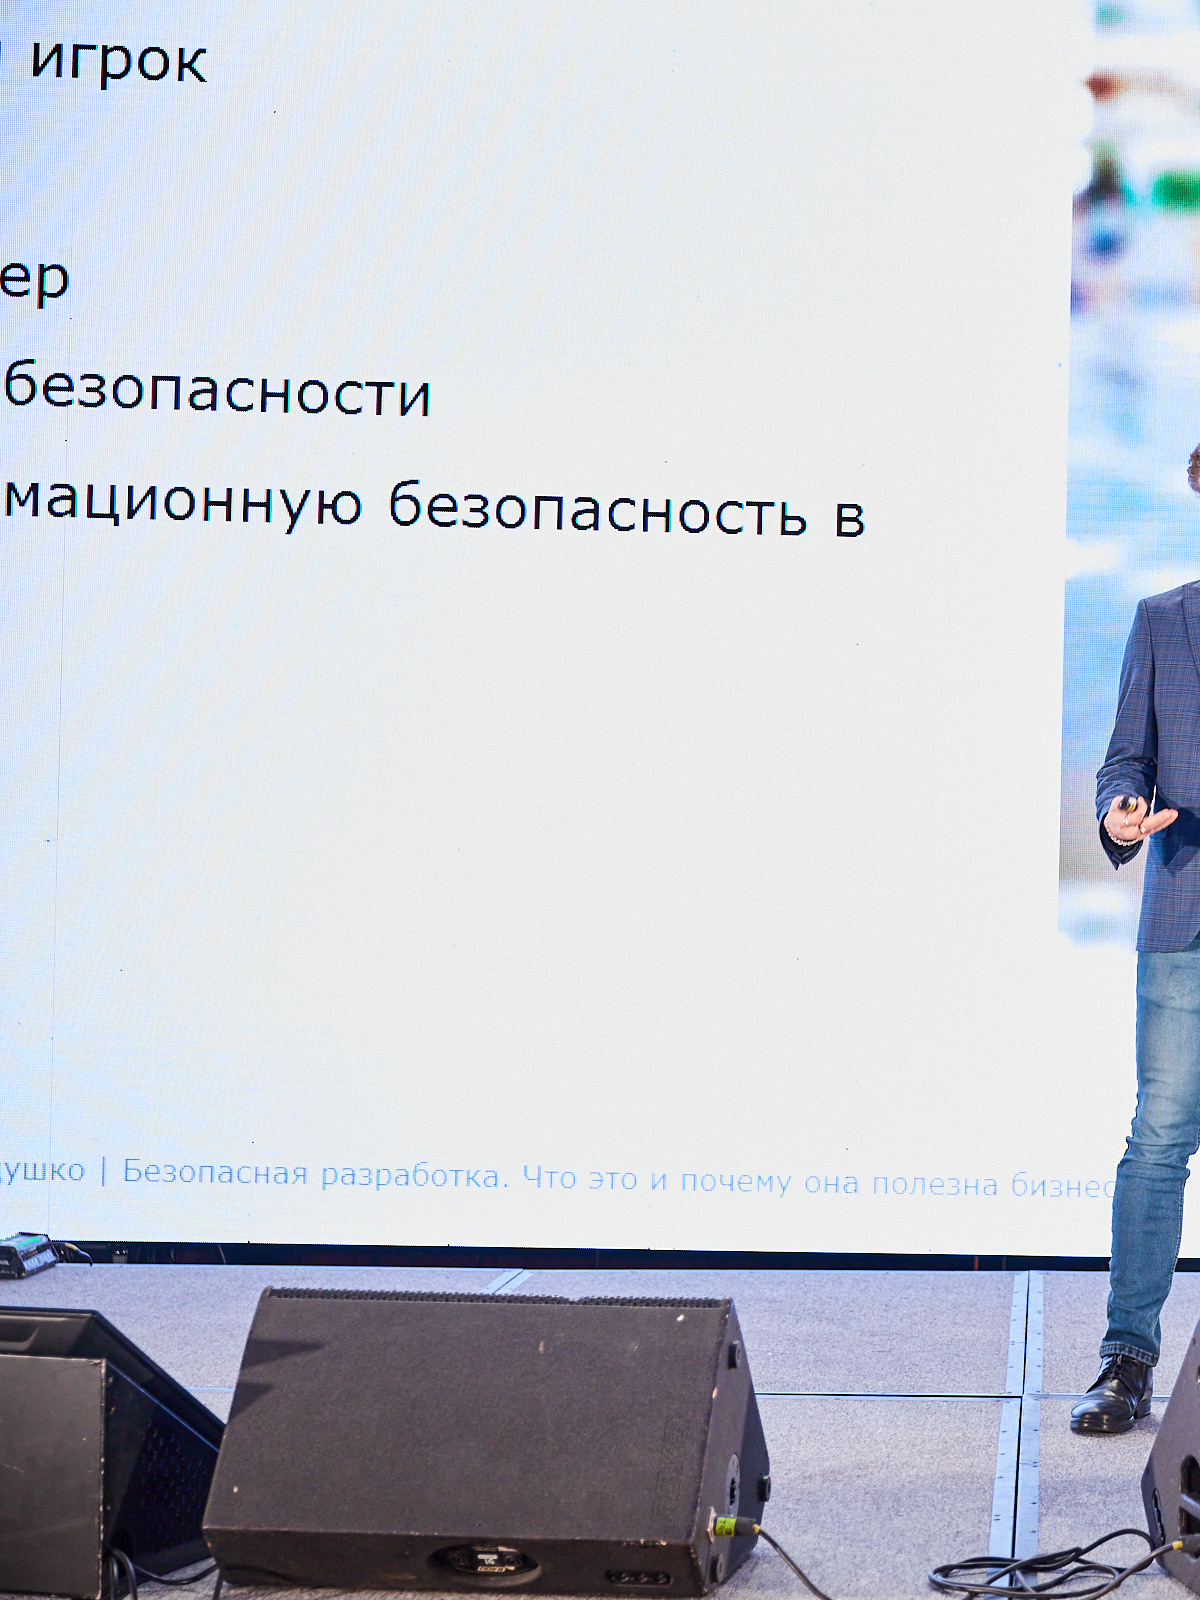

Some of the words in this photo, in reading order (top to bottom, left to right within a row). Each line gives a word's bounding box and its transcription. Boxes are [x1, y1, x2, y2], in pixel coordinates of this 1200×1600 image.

[32, 42, 208, 91] игрок
[5, 358, 430, 417] безопасности
[5, 480, 361, 535] мационную
[390, 479, 808, 536] безопасность
[836, 503, 865, 538] в
[0, 1161, 86, 1186] ушко
[122, 1157, 308, 1185] Безопасная
[321, 1161, 509, 1192] разработка.
[523, 1164, 576, 1190] Что
[588, 1171, 638, 1190] это
[651, 1173, 667, 1191] и
[681, 1173, 793, 1199] почему
[804, 1175, 859, 1194] она
[873, 1176, 998, 1197] полезна
